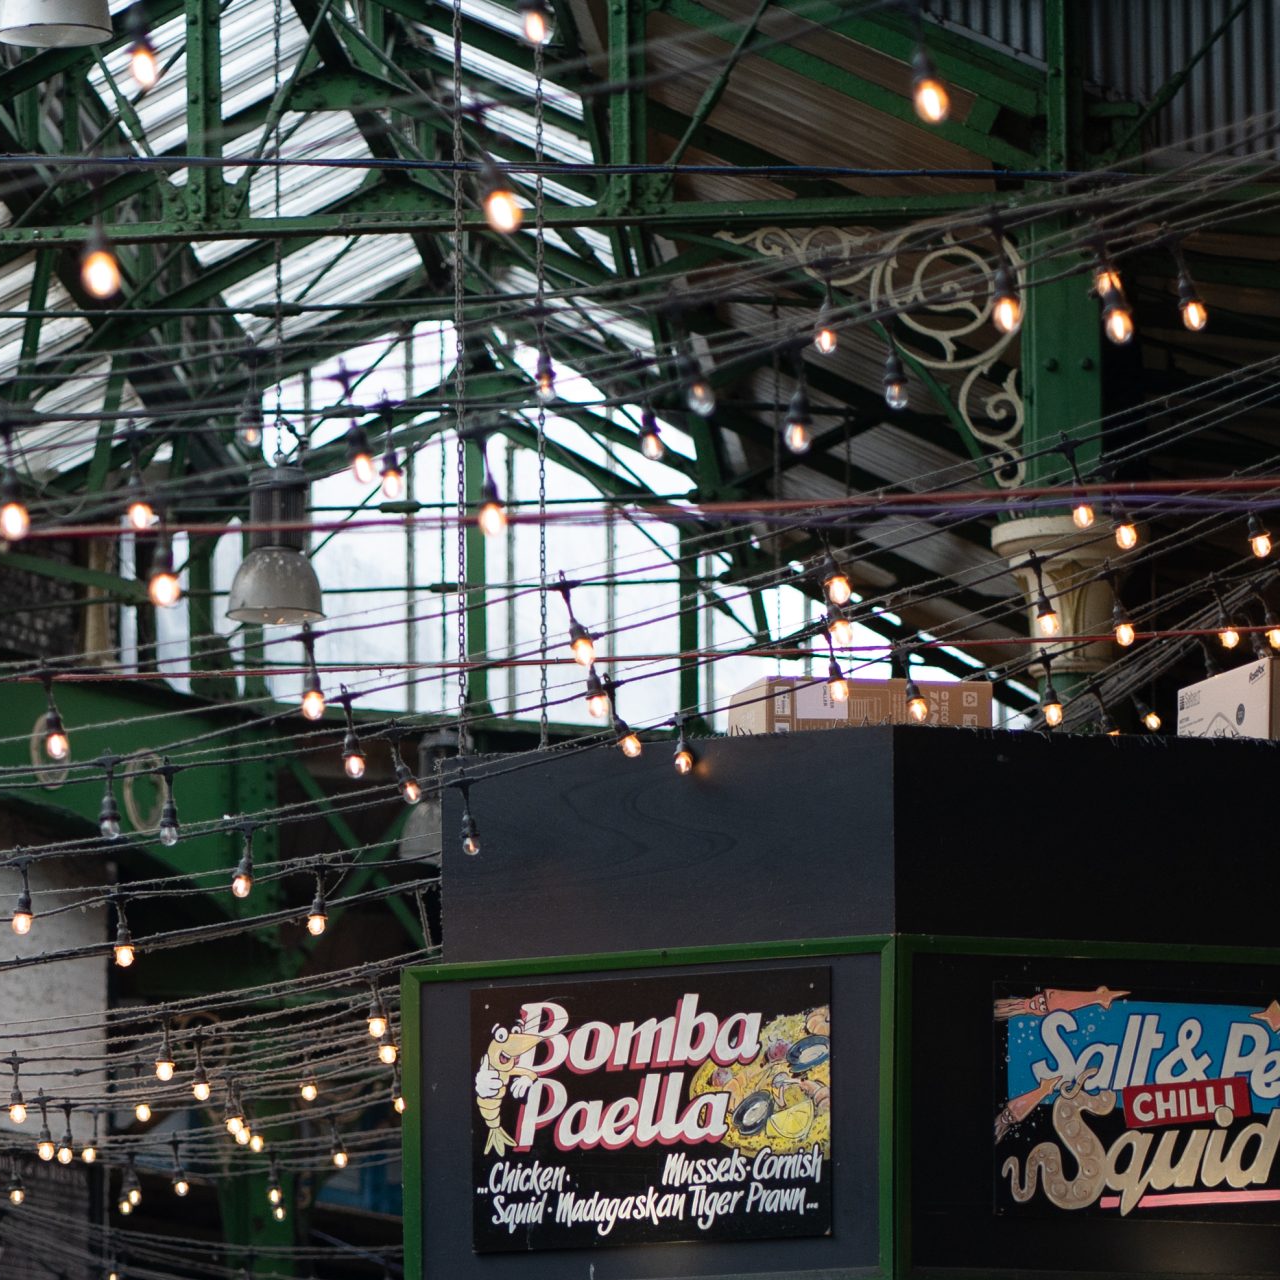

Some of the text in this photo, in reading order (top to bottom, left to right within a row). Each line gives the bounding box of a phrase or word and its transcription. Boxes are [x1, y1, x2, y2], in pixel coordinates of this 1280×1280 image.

[521, 993, 762, 1074] Bomba
[1032, 1010, 1164, 1091] Salt
[514, 1072, 731, 1152] Paella
[1132, 1084, 1235, 1122] CHILLI
[1002, 1090, 1280, 1217] Squid
[491, 1192, 548, 1234] Squid
[555, 1185, 686, 1237] Madagaskan
[689, 1184, 745, 1230] Tiger
